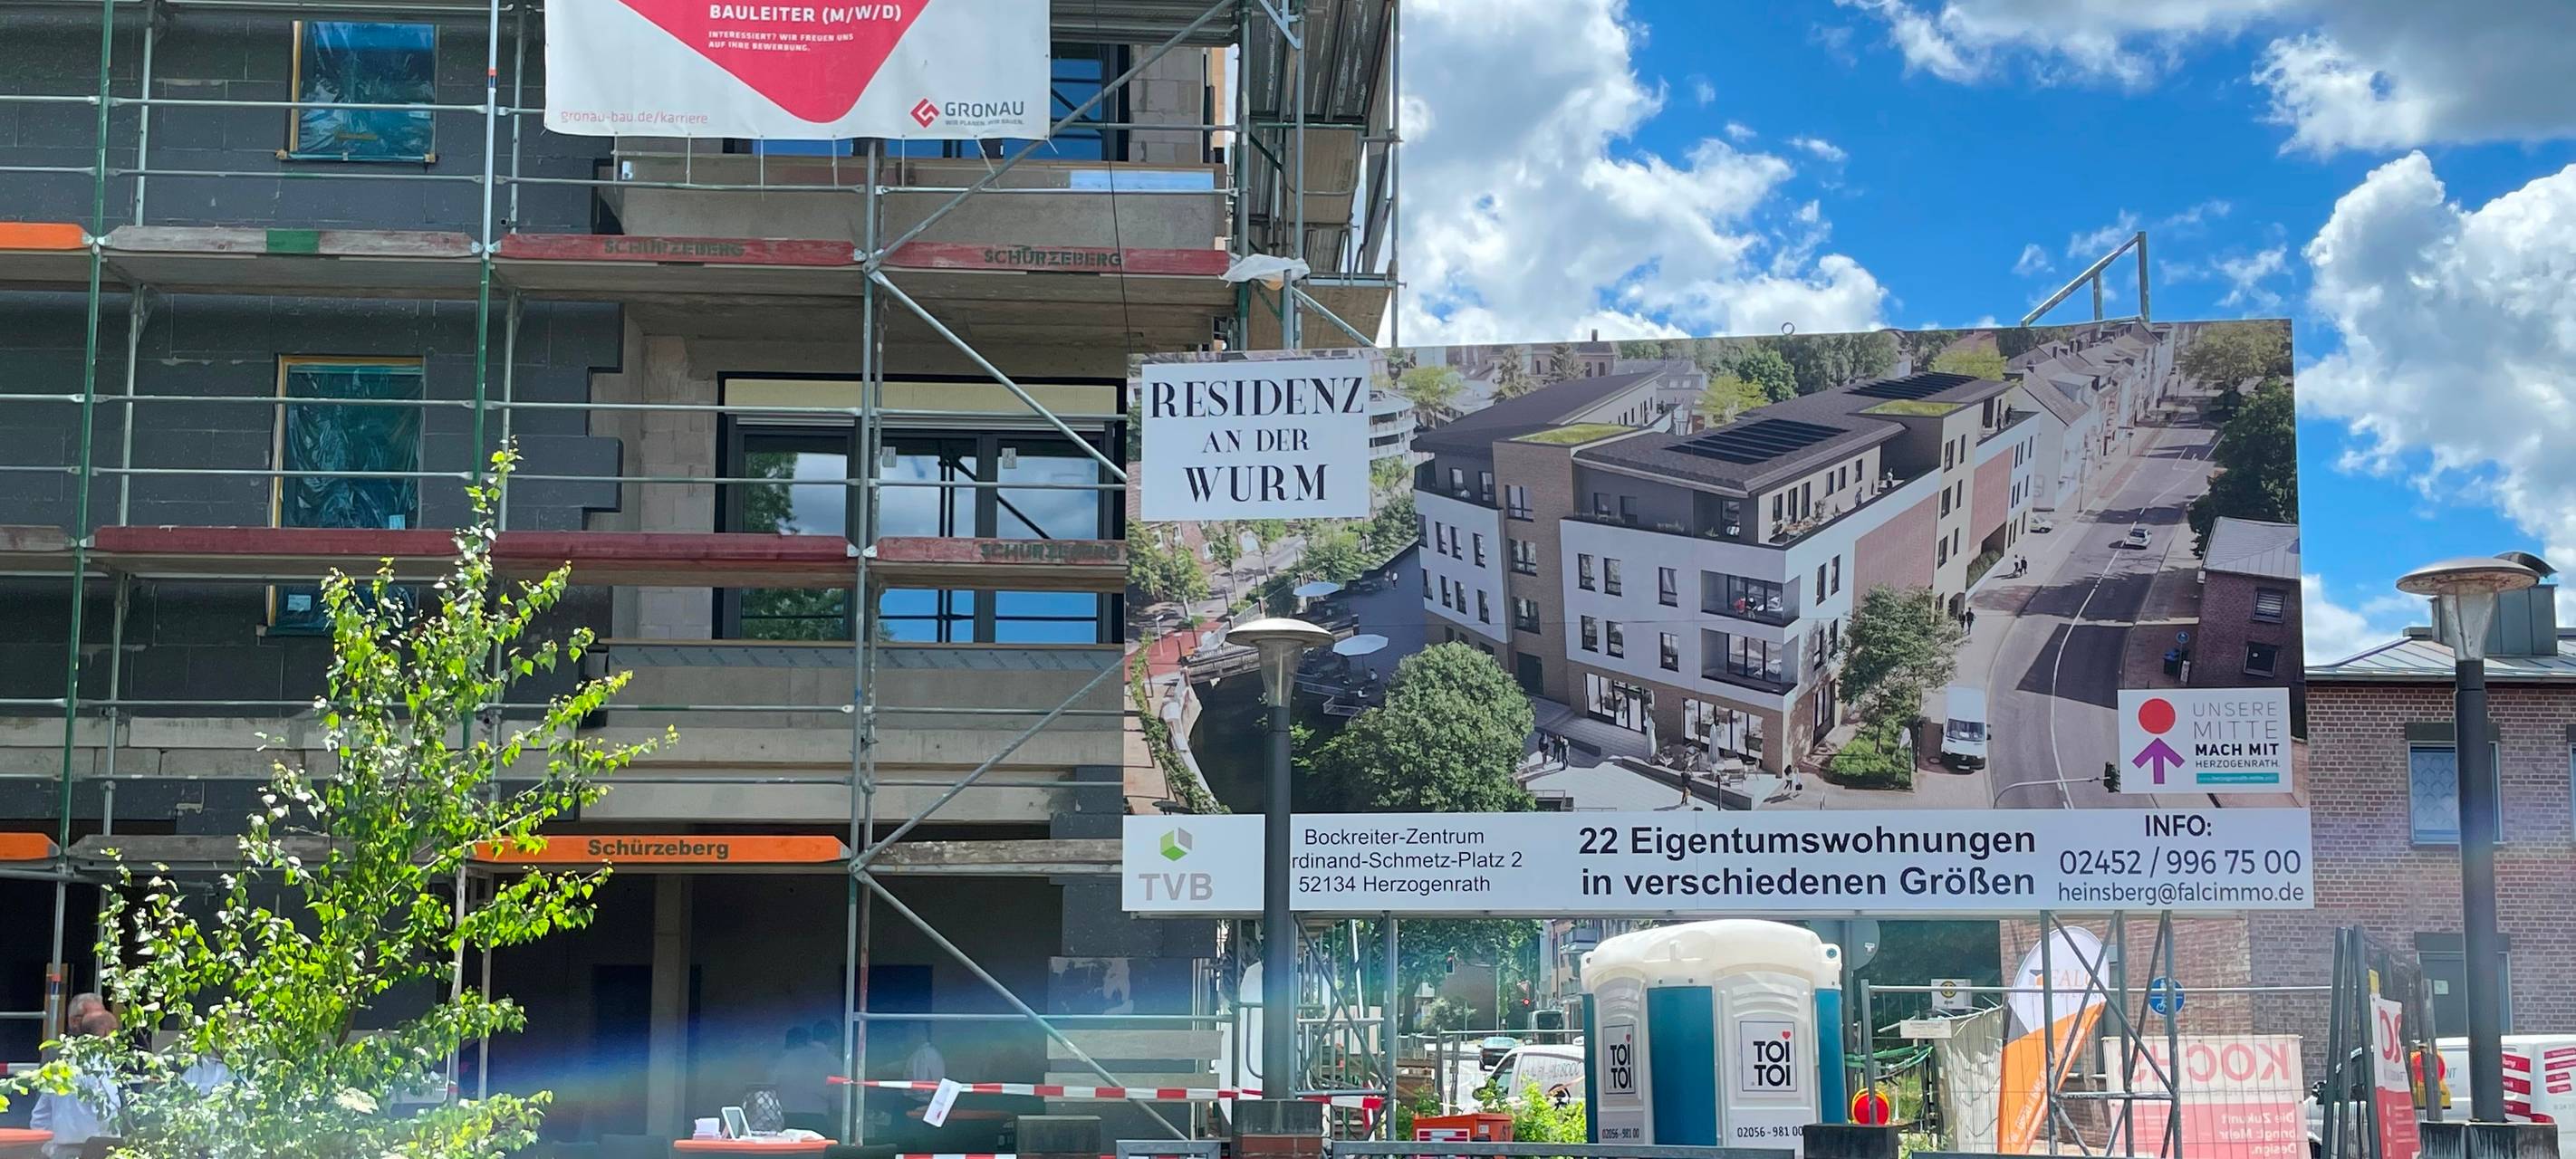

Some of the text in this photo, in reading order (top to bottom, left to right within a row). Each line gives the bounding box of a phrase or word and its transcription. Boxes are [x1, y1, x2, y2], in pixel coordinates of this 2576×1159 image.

[709, 4, 902, 24] BAULEITER (M/W/D)
[708, 31, 854, 42] INTERESSIERT? WIR FREUEN UNS
[728, 42, 749, 50] IHRE
[752, 43, 812, 52] BEWERBUNG.
[561, 110, 708, 124] gronau-bau.de/karriere
[945, 101, 1024, 118] GRONAU
[1149, 377, 1364, 418] RESIDENZ
[1202, 428, 1311, 453] AN DER
[1182, 464, 1330, 503] WURM
[2193, 701, 2278, 717] UNSERE
[2193, 720, 2279, 740] MITTE
[2195, 742, 2280, 757] MACH MIT
[1304, 827, 1485, 846] Bockreiter-Zentrum
[2145, 814, 2213, 838] INFO:
[589, 838, 729, 860] Schürzeberg
[1579, 825, 2036, 861] 22 Eigentumswohnungen
[1292, 851, 1523, 870] rdinand-Schmetz-Platz 2
[2059, 846, 2302, 878] 02452 / 996 75 00
[1139, 872, 1214, 902] TVB
[1298, 875, 1491, 896] 52134 Herzogenrath
[1581, 864, 2035, 896] in verschiedenen Größen
[2058, 881, 2304, 905] heinsberg@falcimmo.de
[1610, 1044, 1630, 1066] TOI
[1753, 1040, 1790, 1063] TOI
[1610, 1067, 1632, 1089] TOI
[1754, 1064, 1791, 1087] TOI
[1736, 1126, 1765, 1138] 02056
[1772, 1126, 1790, 1137] 981
